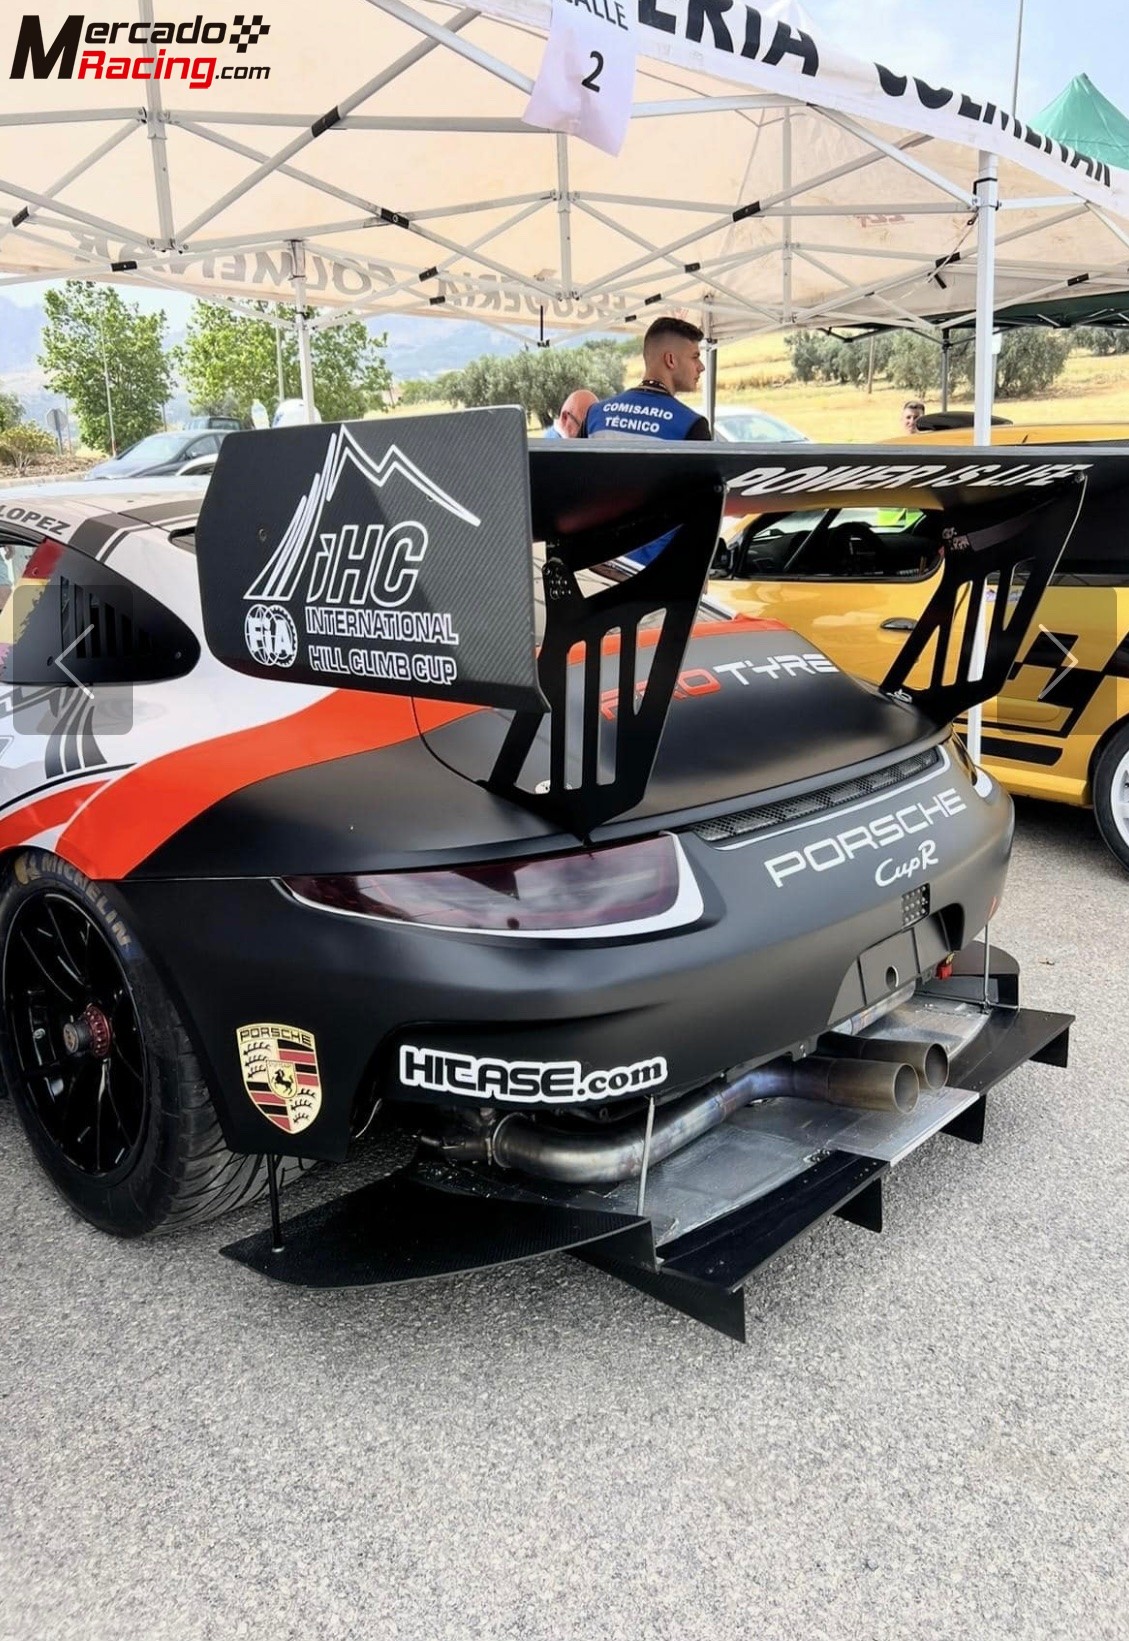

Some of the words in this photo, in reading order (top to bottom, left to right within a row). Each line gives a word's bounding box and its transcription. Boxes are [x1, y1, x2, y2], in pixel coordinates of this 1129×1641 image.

[566, 0, 629, 31] ALLE
[581, 51, 604, 93] 2
[602, 402, 673, 420] COMISARIO
[605, 415, 660, 433] TÉCNICO
[726, 465, 947, 496] POWER
[910, 464, 1002, 488] IS
[966, 464, 1094, 487] LIFE
[305, 606, 459, 645] INTERNATIONAL
[308, 645, 350, 675] HILL
[350, 648, 412, 681] CLIMB
[411, 653, 458, 685] CUP
[764, 788, 967, 888] PORSCHE
[240, 1027, 312, 1047] PORSCHE
